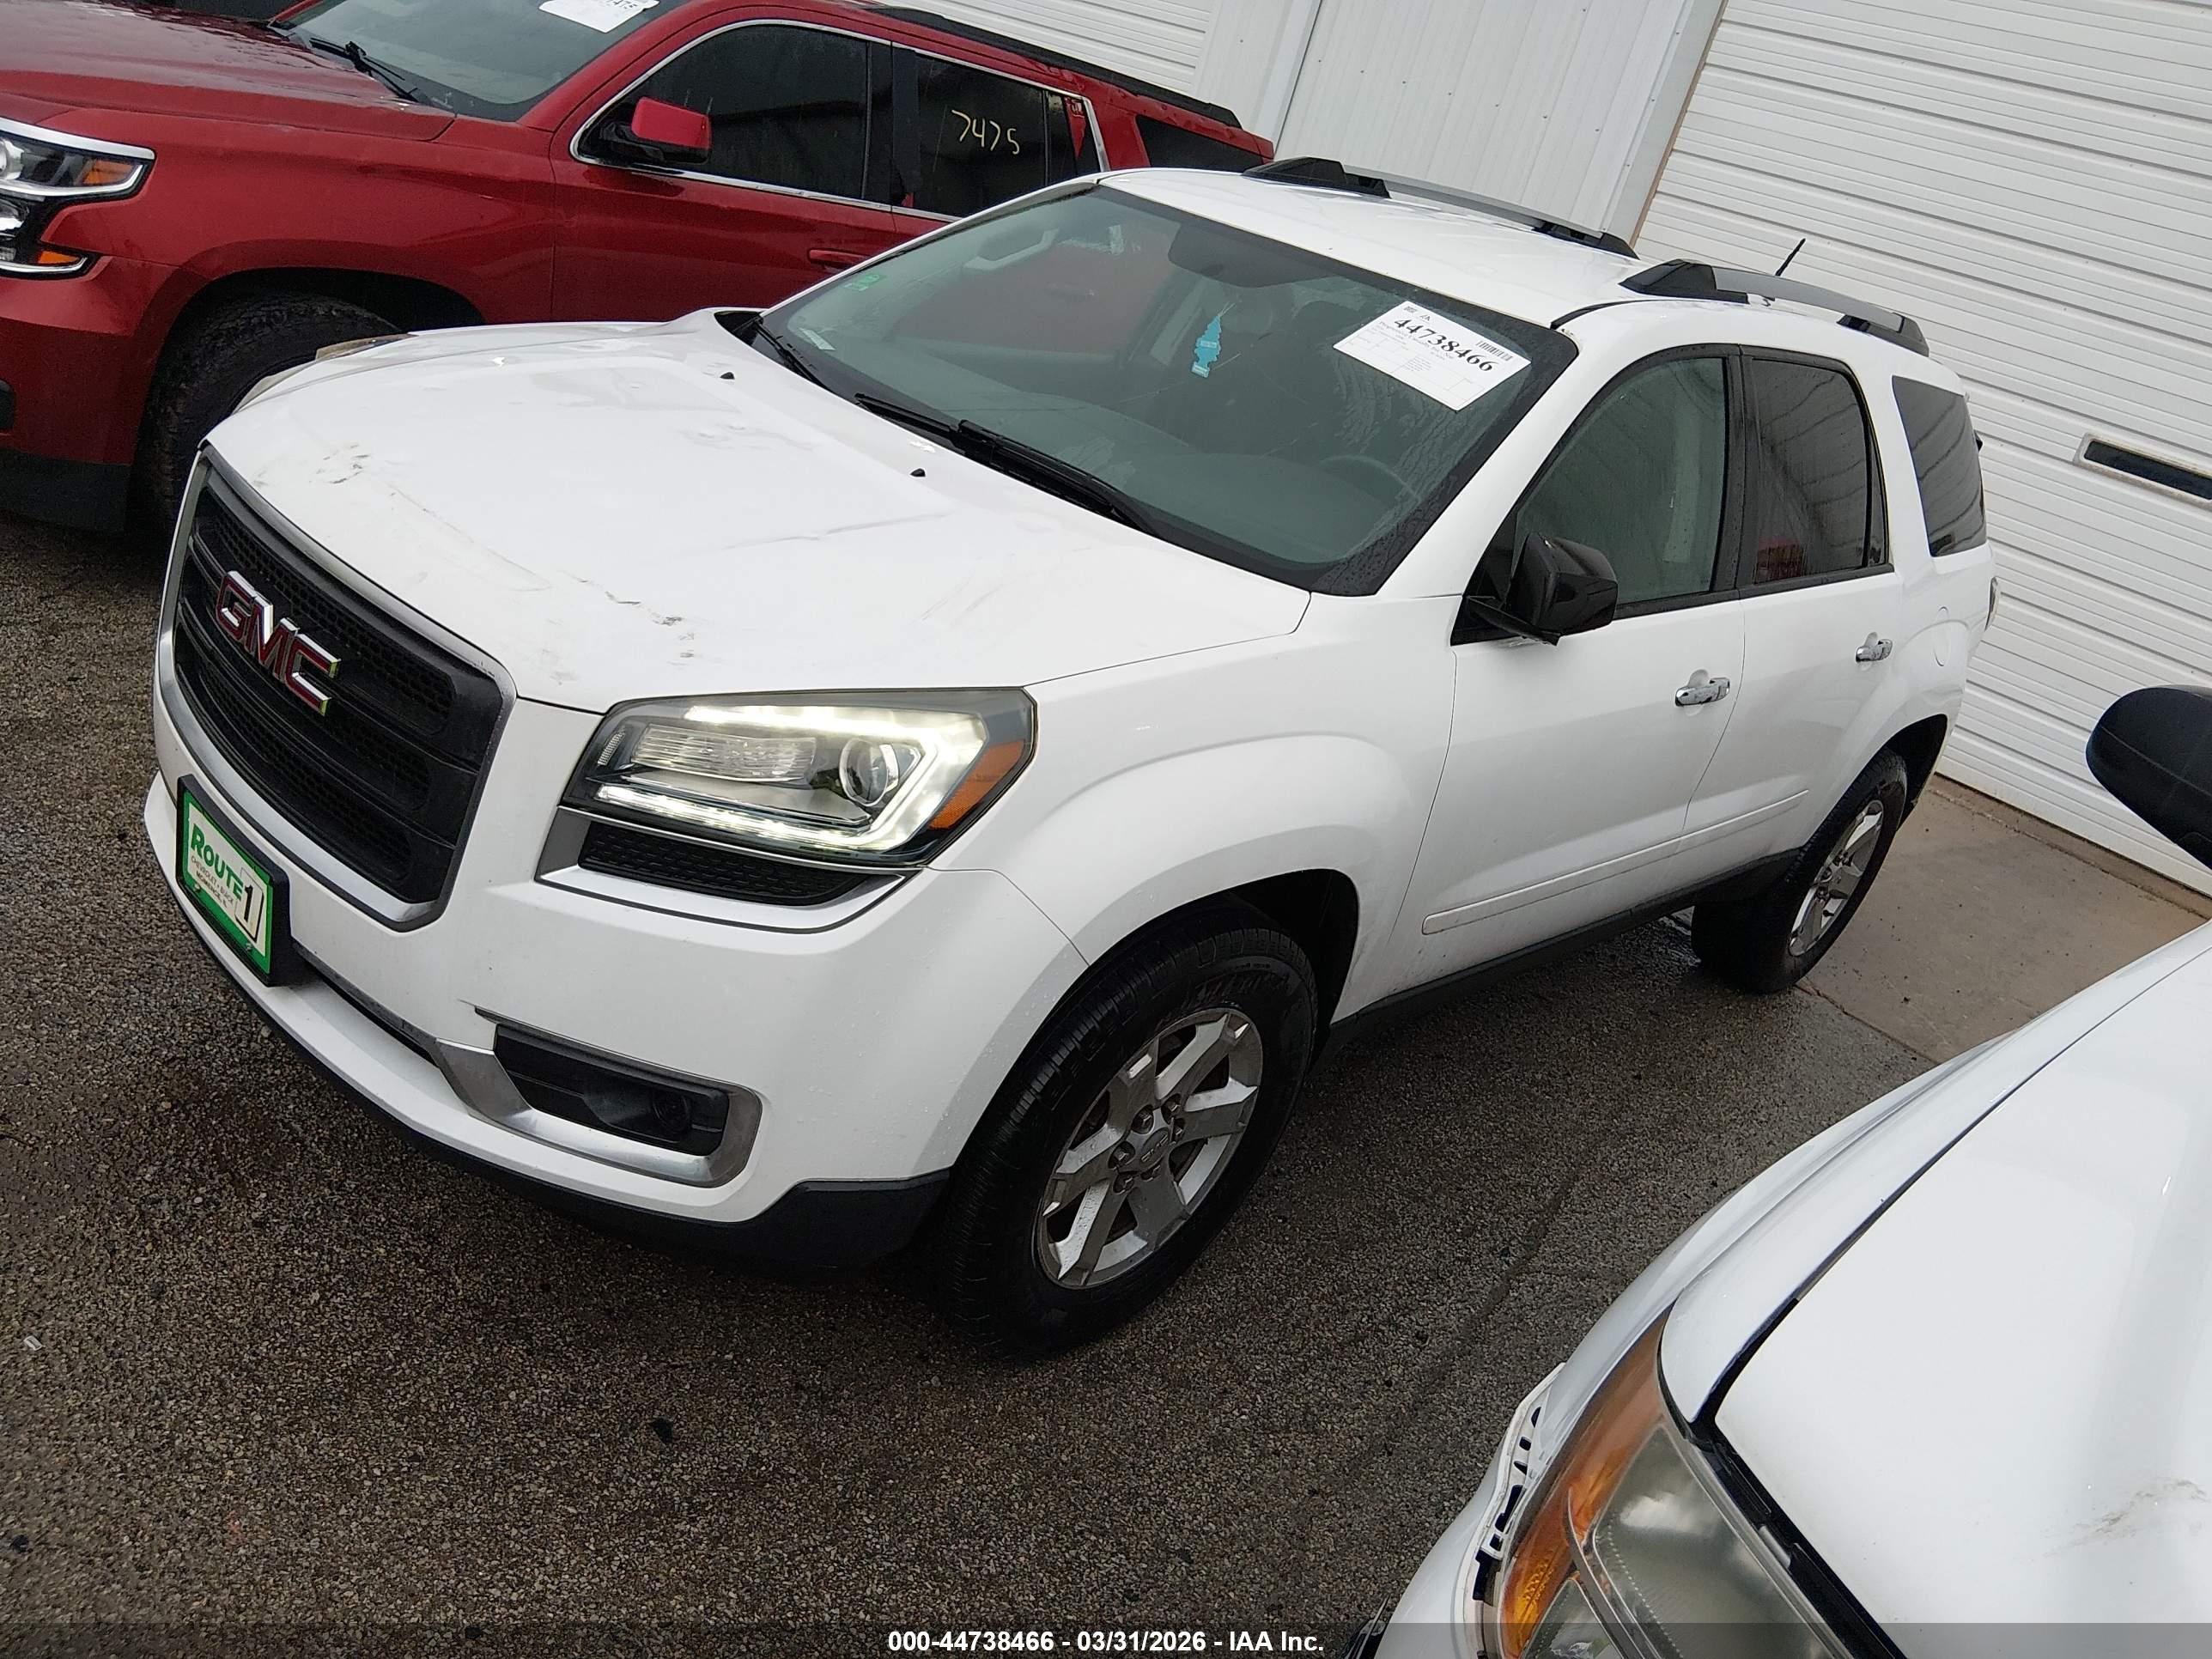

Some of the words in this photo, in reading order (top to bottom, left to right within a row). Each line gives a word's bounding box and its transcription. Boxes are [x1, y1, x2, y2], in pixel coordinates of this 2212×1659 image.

[951, 109, 1020, 155] 7475
[1394, 319, 1499, 372] 44738466
[215, 570, 342, 716] GMC
[191, 823, 244, 902] ROUTE
